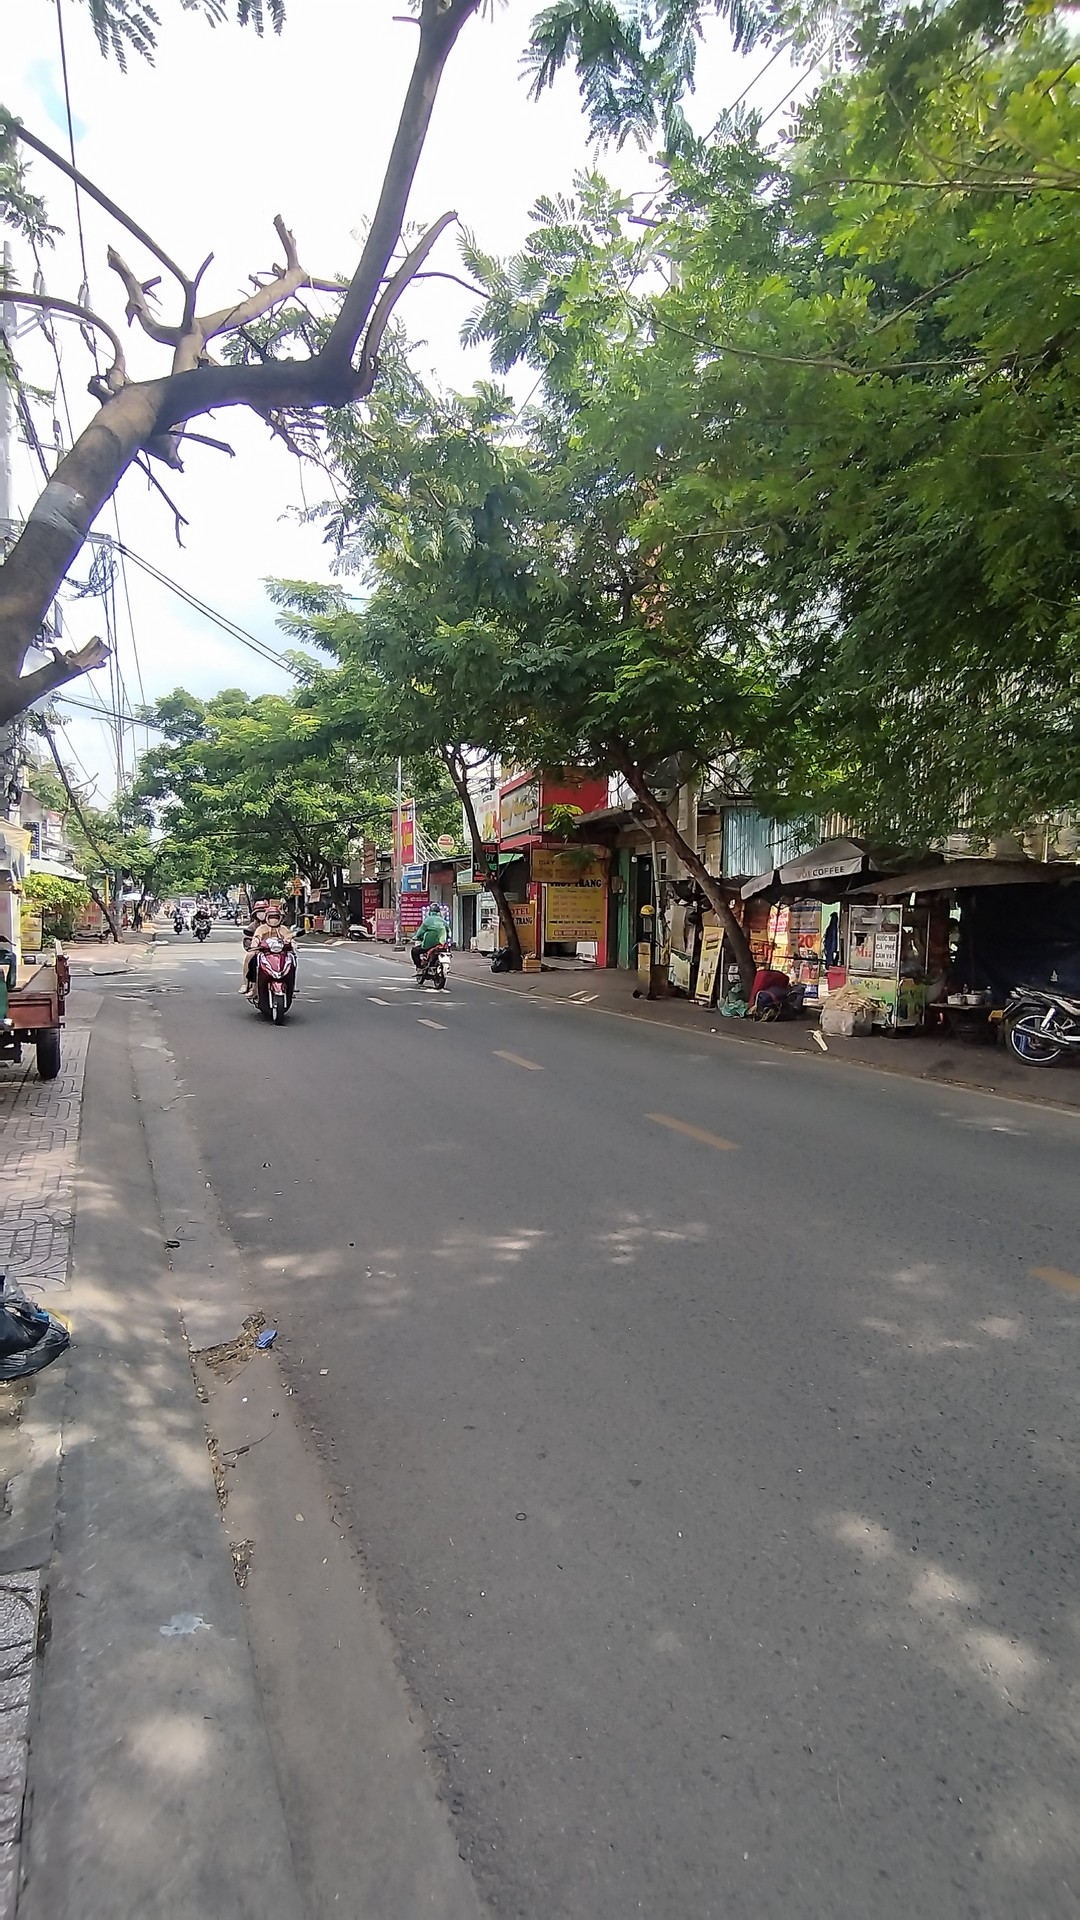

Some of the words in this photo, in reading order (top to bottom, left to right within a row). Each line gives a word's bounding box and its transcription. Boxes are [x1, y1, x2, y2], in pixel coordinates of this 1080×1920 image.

[812, 866, 845, 876] COFFEE
[510, 907, 530, 915] OTEL
[515, 917, 533, 925] TRANG
